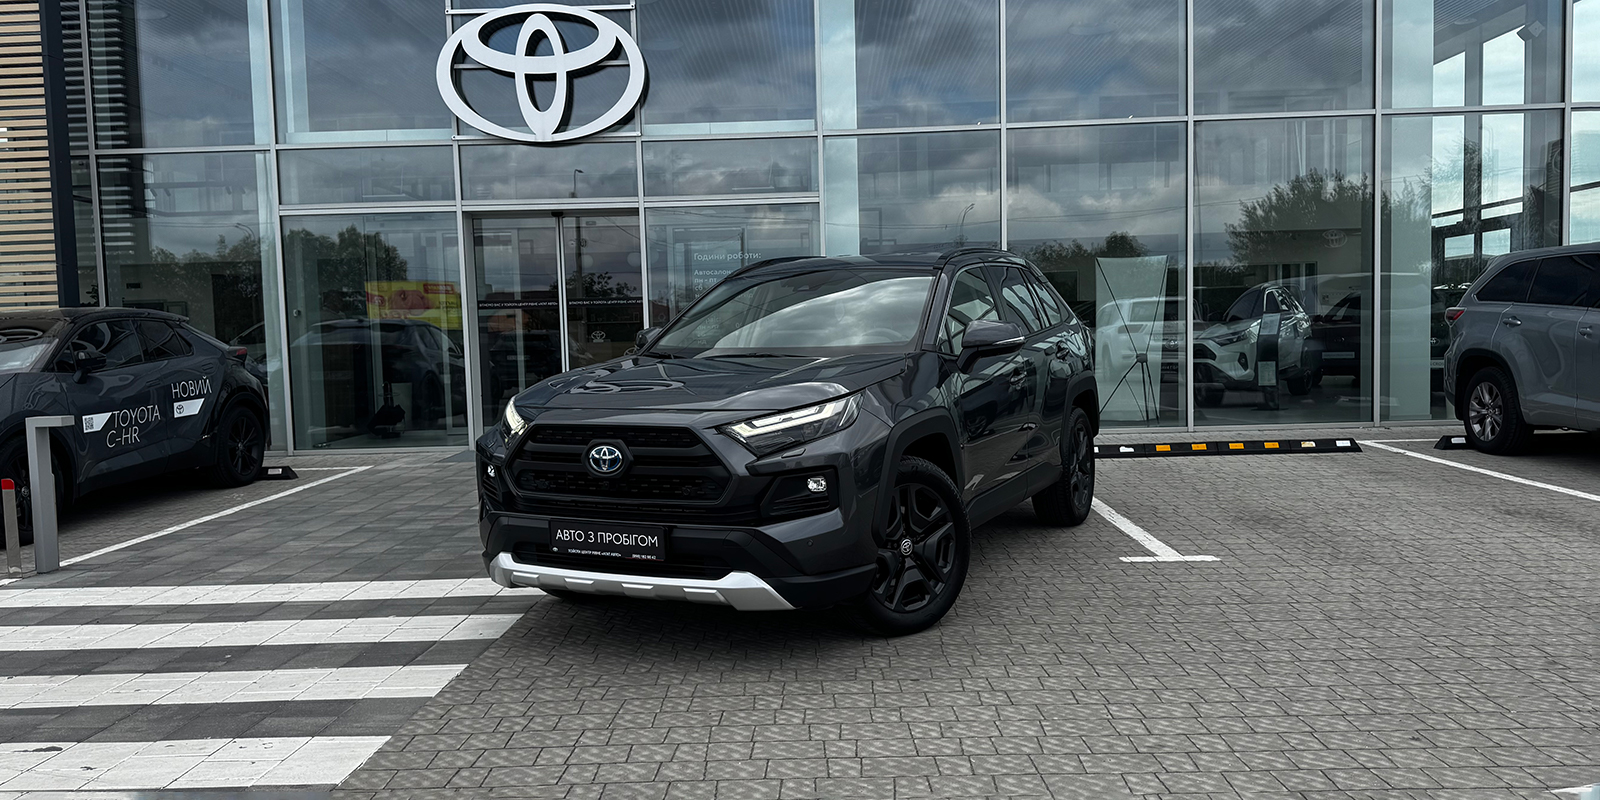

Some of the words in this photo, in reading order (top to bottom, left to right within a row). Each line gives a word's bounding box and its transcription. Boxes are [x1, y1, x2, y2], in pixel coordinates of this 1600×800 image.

[694, 252, 725, 262] Години
[727, 251, 762, 261] роботи:
[171, 375, 212, 400] НОВИЙ
[113, 404, 161, 428] TOYOTA
[106, 425, 141, 448] C-HR
[556, 529, 585, 542] АВТО
[597, 531, 659, 548] ПРОБІГОМ
